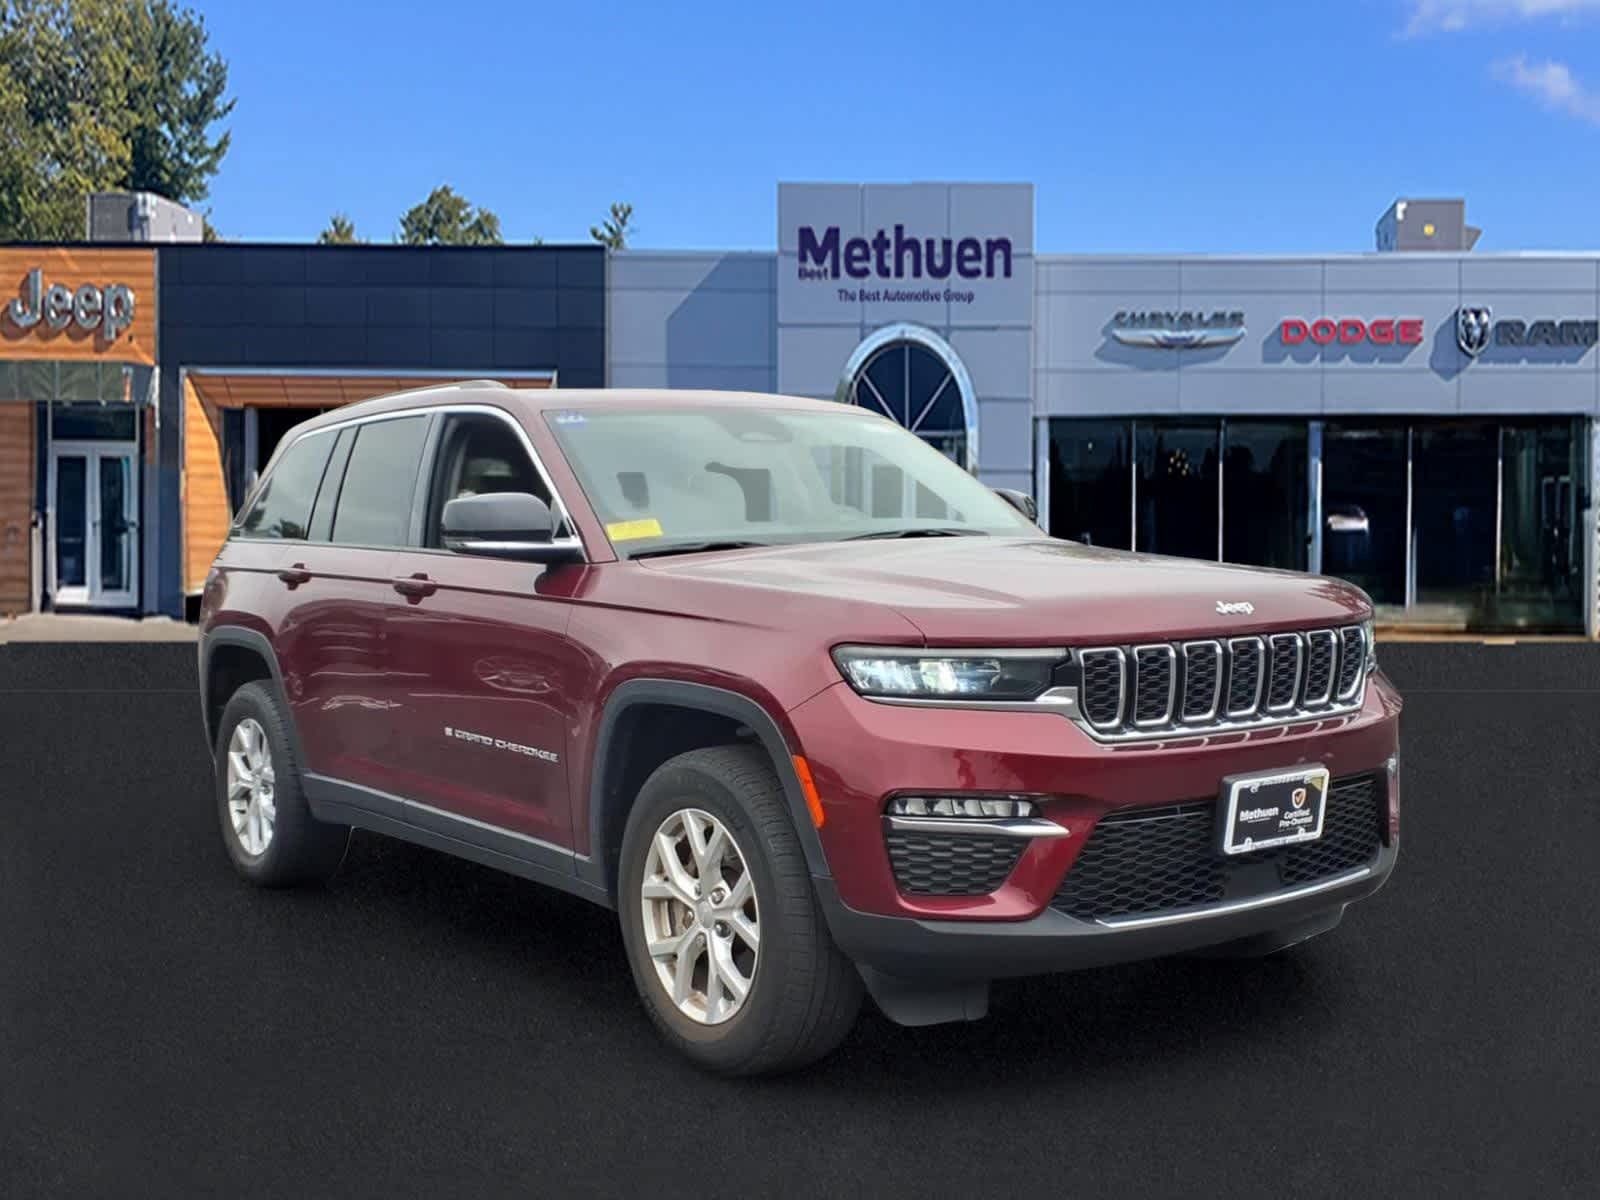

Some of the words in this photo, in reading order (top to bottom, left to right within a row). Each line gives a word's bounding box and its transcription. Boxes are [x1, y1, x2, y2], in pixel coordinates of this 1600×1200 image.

[798, 224, 1012, 280] Methuen
[9, 268, 135, 341] Jeep
[837, 288, 857, 302] The
[859, 288, 881, 302] Best
[883, 288, 941, 302] Automotive
[943, 288, 975, 304] Group
[1281, 319, 1424, 345] DODGE
[1494, 320, 1600, 347] RAM
[1215, 600, 1255, 615] Jeep
[1239, 807, 1279, 821] Methuen
